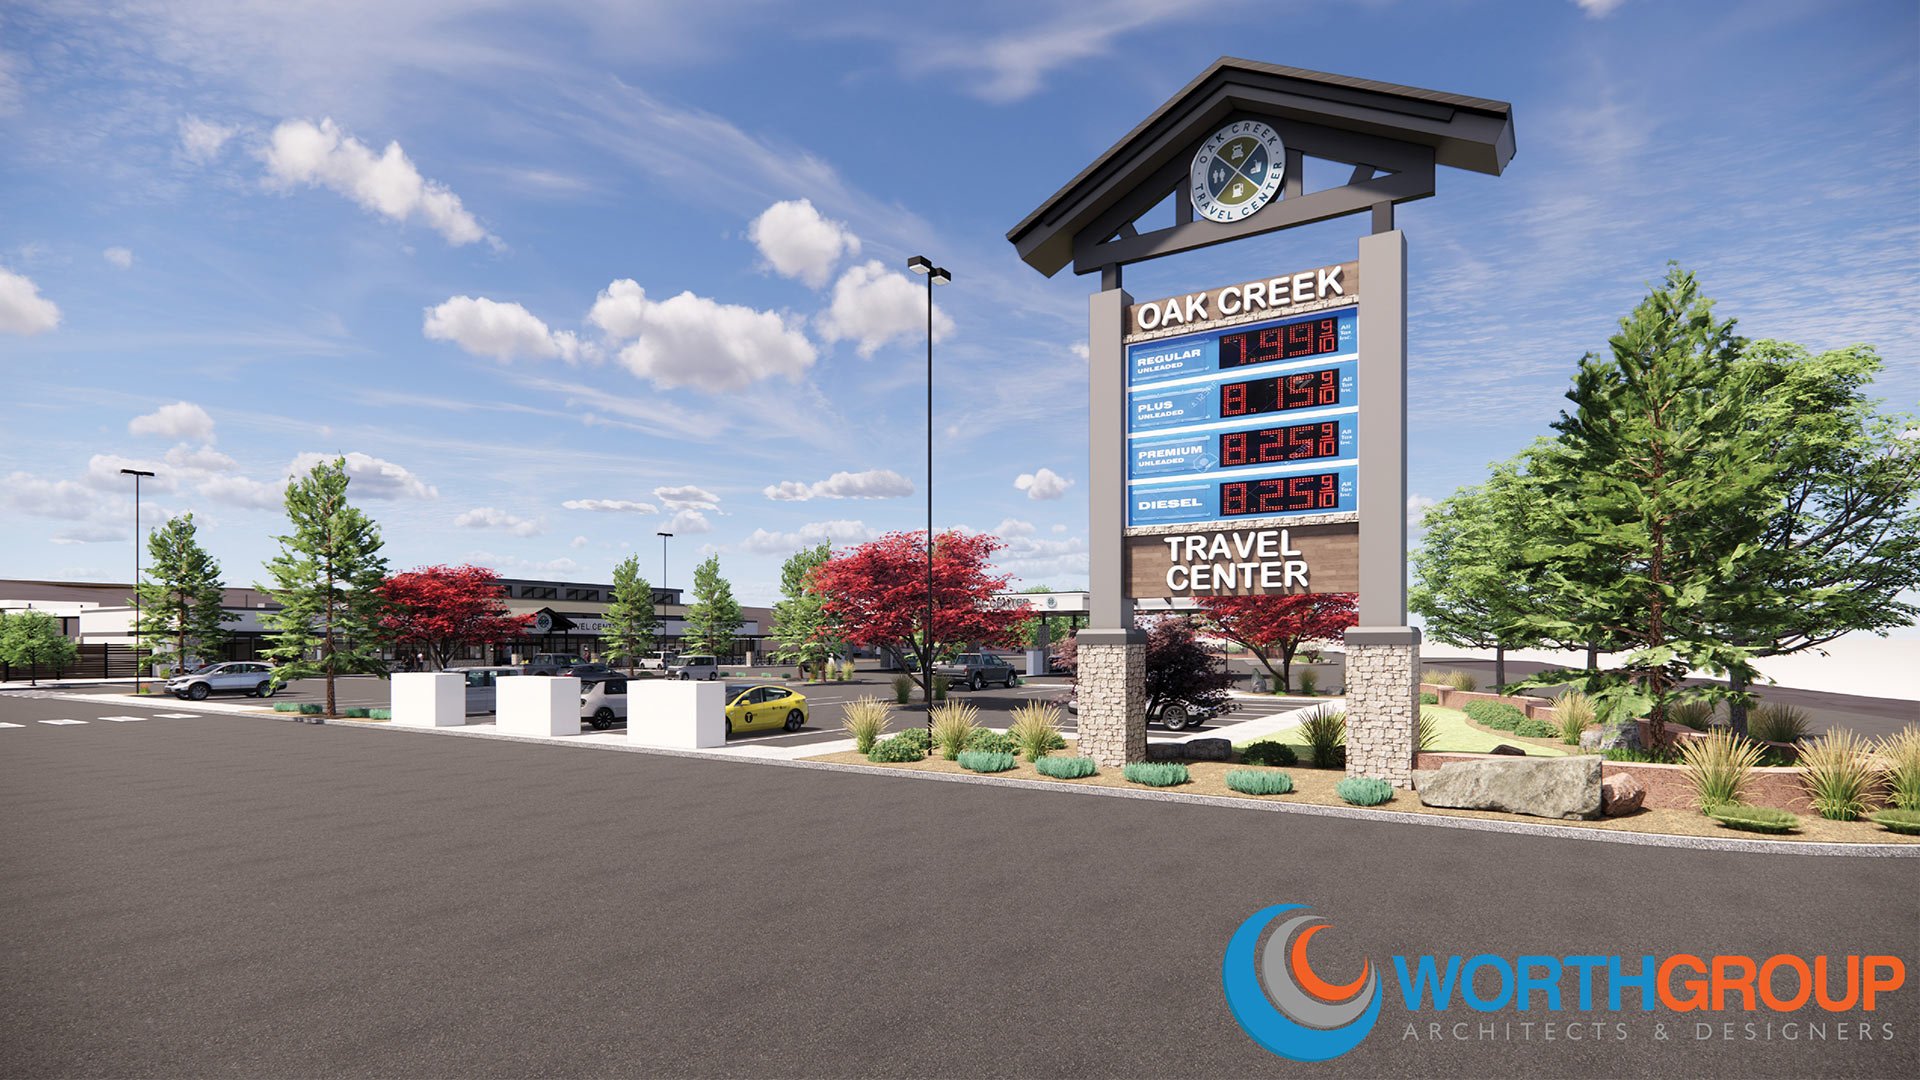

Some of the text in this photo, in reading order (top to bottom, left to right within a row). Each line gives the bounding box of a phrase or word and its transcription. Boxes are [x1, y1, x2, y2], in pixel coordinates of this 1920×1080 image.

[1199, 122, 1277, 164] OAK CREEK
[1195, 162, 1282, 220] TRAVEL CENTER
[1137, 265, 1344, 330] OAK CREEK
[1137, 349, 1201, 367] REGULAR
[1137, 362, 1183, 374] UNLEADED
[1138, 401, 1173, 413] PLUS
[1138, 409, 1184, 420] UNLEADED
[1138, 445, 1203, 459] PREMIUM
[1138, 457, 1184, 467] UNLEADED
[1138, 498, 1203, 511] DIESEL
[1164, 529, 1301, 562] TRAVEL
[1166, 560, 1309, 591] CENTER
